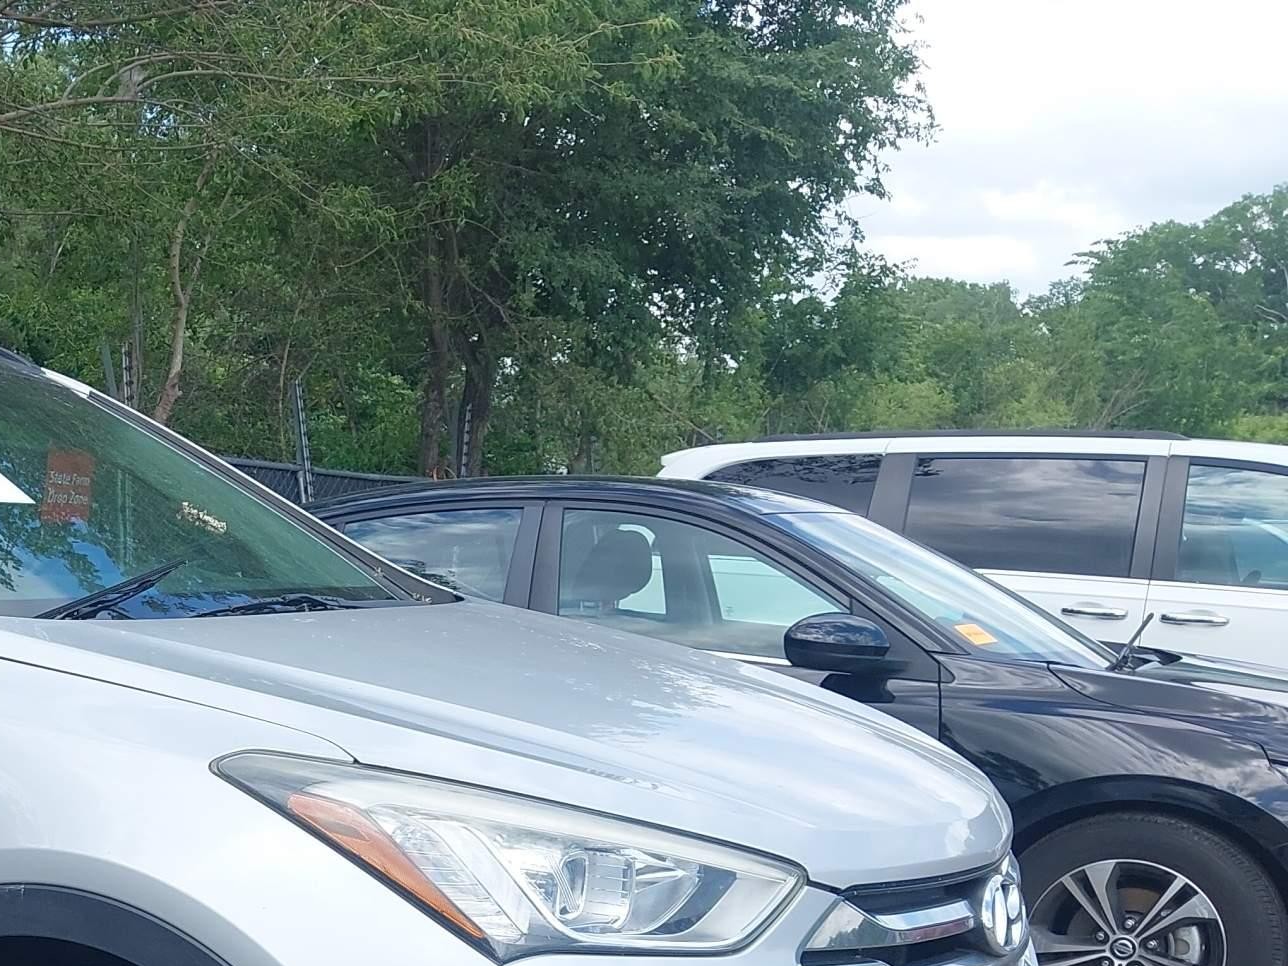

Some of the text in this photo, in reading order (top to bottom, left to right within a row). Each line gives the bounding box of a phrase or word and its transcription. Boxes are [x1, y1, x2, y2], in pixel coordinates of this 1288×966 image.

[48, 470, 90, 486] State Farm
[47, 487, 89, 505] Drop Zone
